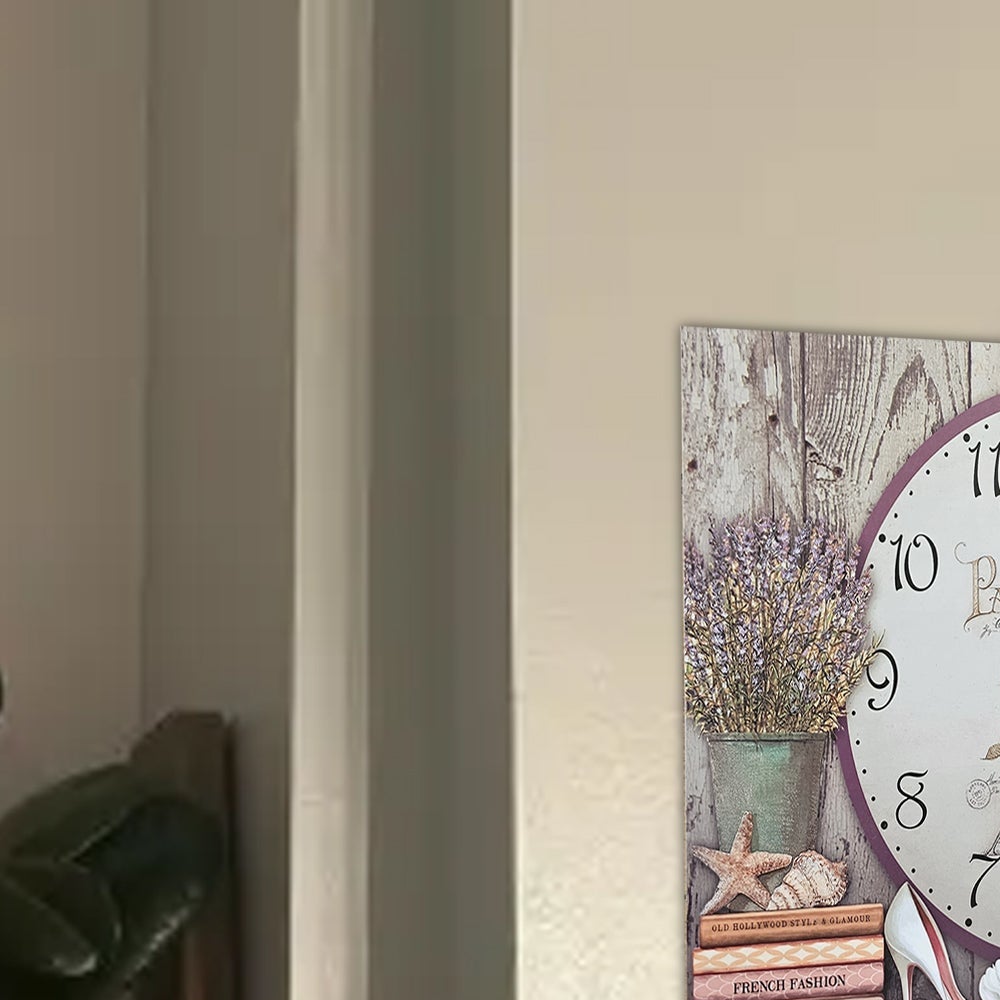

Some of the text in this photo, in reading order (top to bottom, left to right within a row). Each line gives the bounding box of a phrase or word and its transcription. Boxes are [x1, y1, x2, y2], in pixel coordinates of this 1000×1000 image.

[889, 533, 939, 592] 10
[866, 648, 899, 711] 9
[895, 769, 929, 830] 8
[711, 924, 730, 932] OLD
[732, 921, 788, 931] HOLLYWOOD
[820, 917, 827, 925] &
[829, 914, 871, 925] GLAMOUR
[733, 974, 846, 995] FRENCH FASHION
